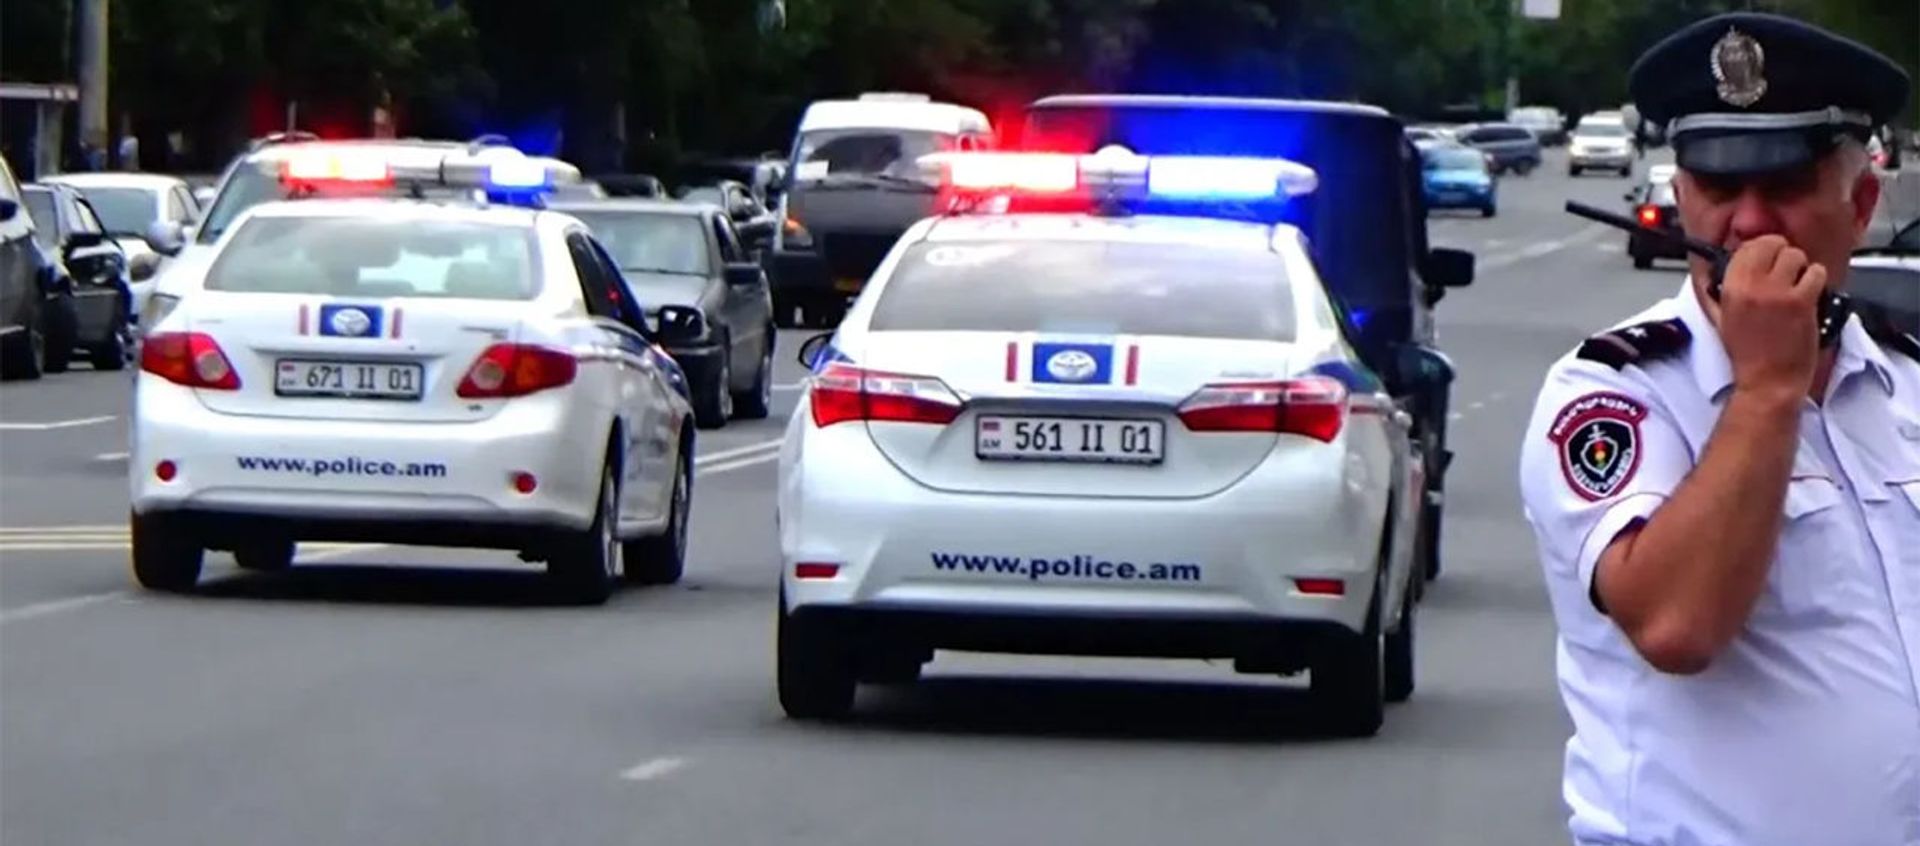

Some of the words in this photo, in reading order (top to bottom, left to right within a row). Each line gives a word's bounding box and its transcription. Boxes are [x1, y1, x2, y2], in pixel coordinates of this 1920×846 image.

[306, 365, 343, 388] 671
[388, 368, 413, 391] 01
[1014, 421, 1063, 452] 561
[1120, 424, 1153, 454] 01
[236, 456, 447, 477] www.police.am
[931, 552, 1200, 581] www.police.am
